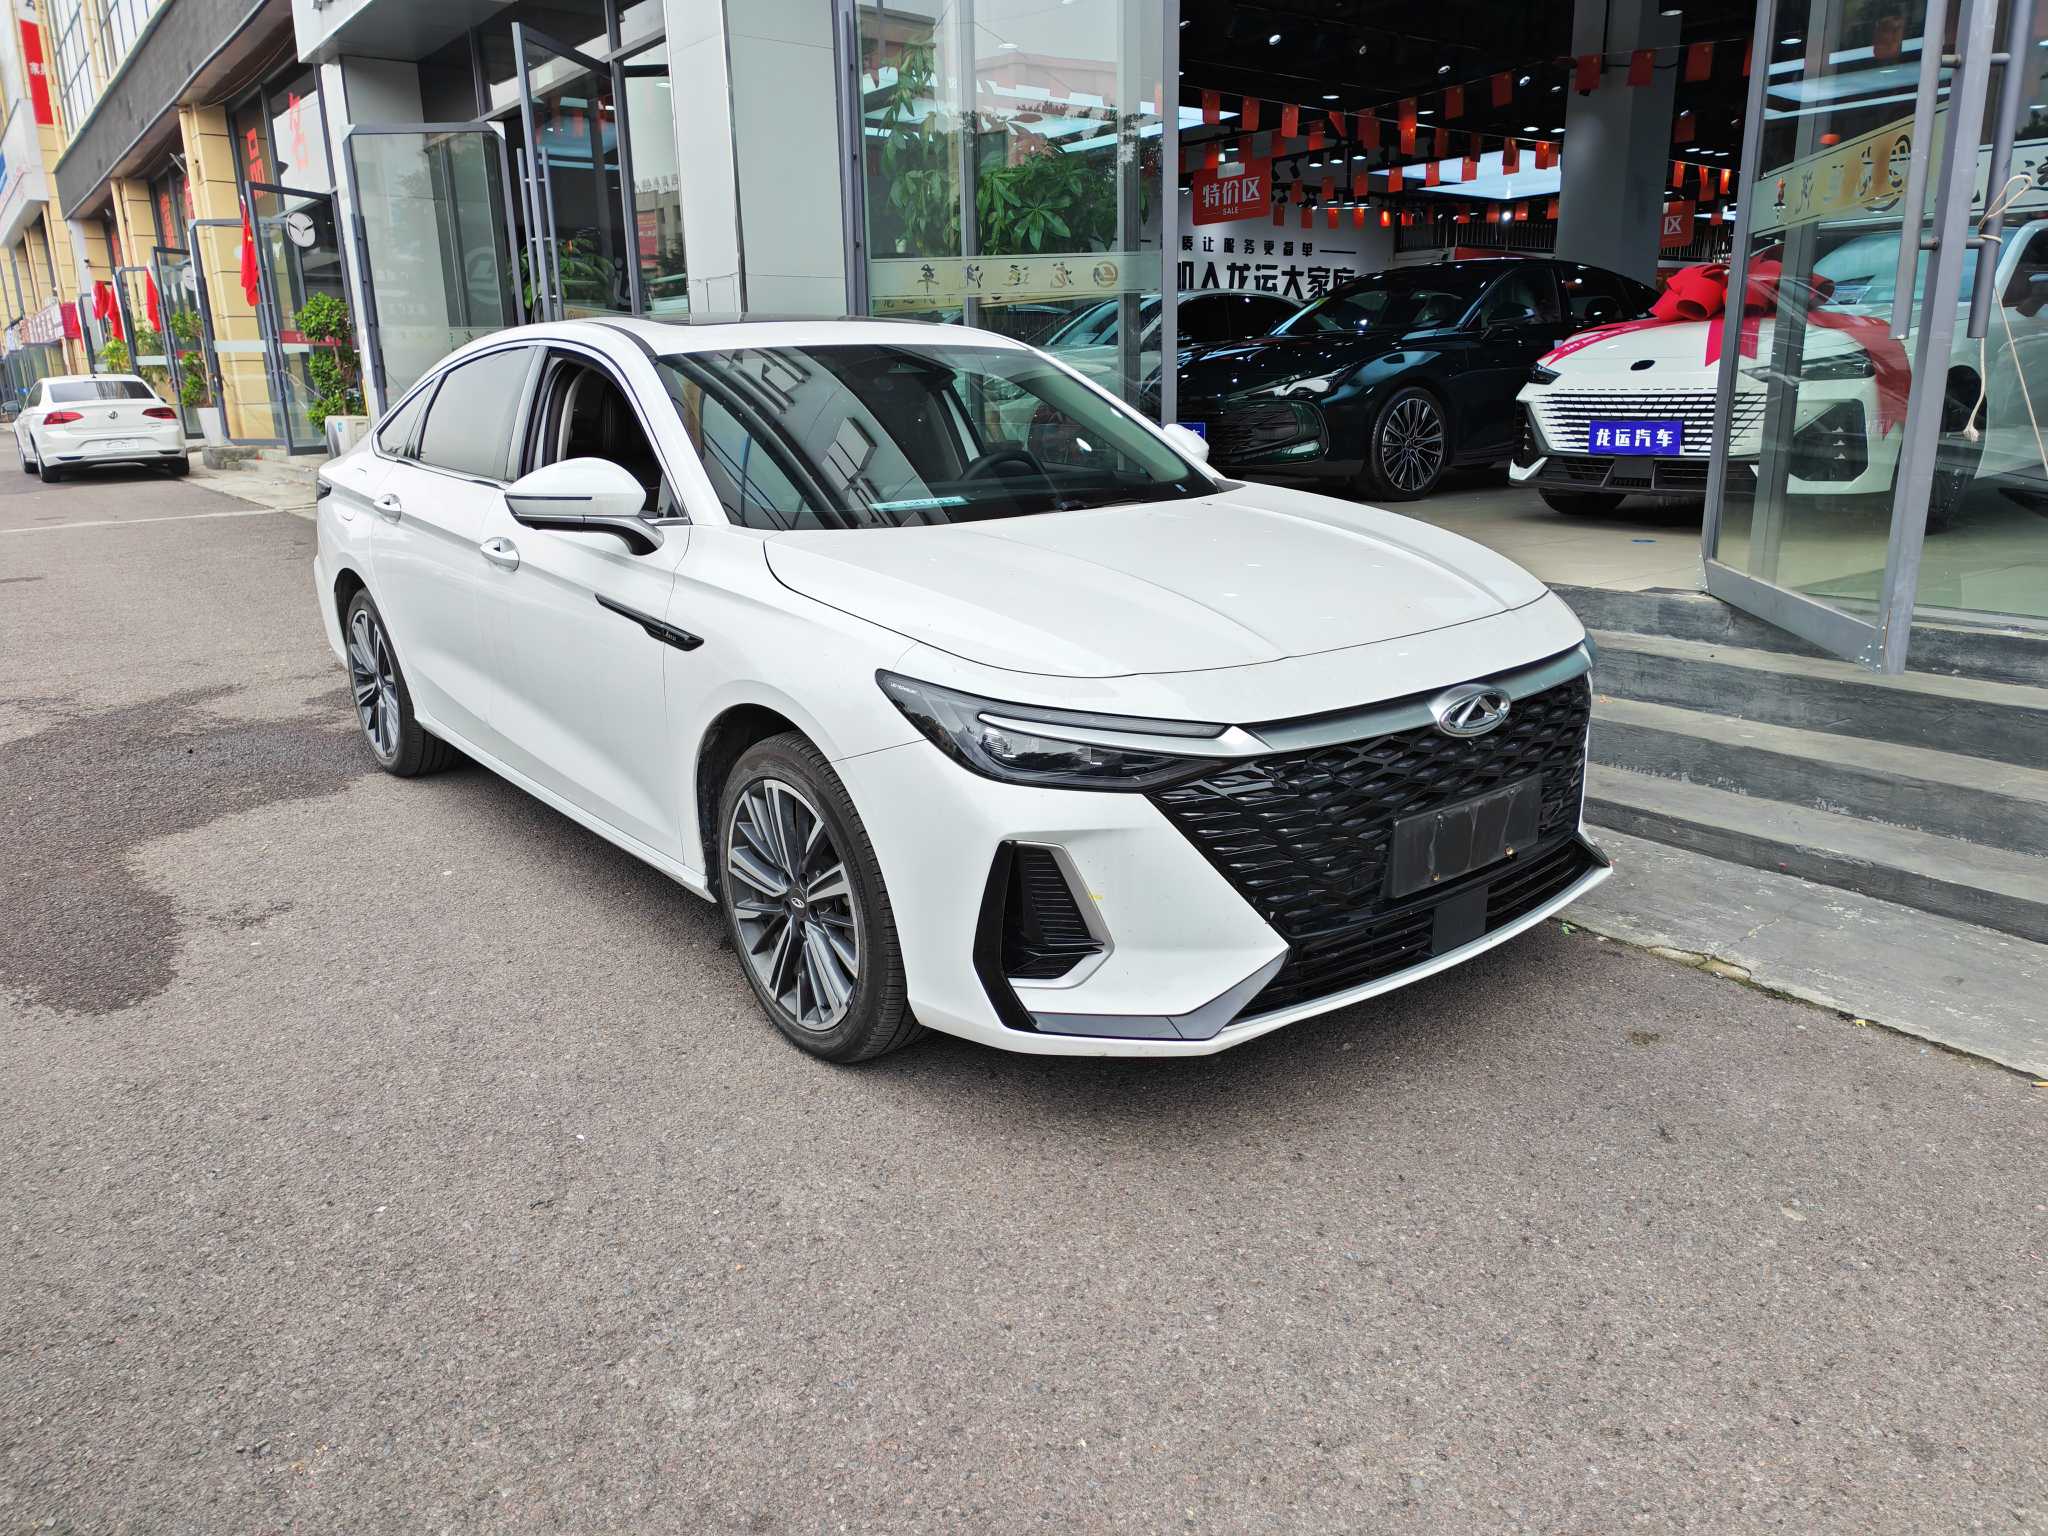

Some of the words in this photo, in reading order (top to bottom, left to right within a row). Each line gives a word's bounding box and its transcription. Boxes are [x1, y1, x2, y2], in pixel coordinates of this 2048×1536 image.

[1202, 176, 1261, 209] 特价区
[1222, 206, 1240, 216] SALE
[1160, 233, 1313, 257] 质让服务更简单
[1596, 428, 1674, 448] 龙运汽车
